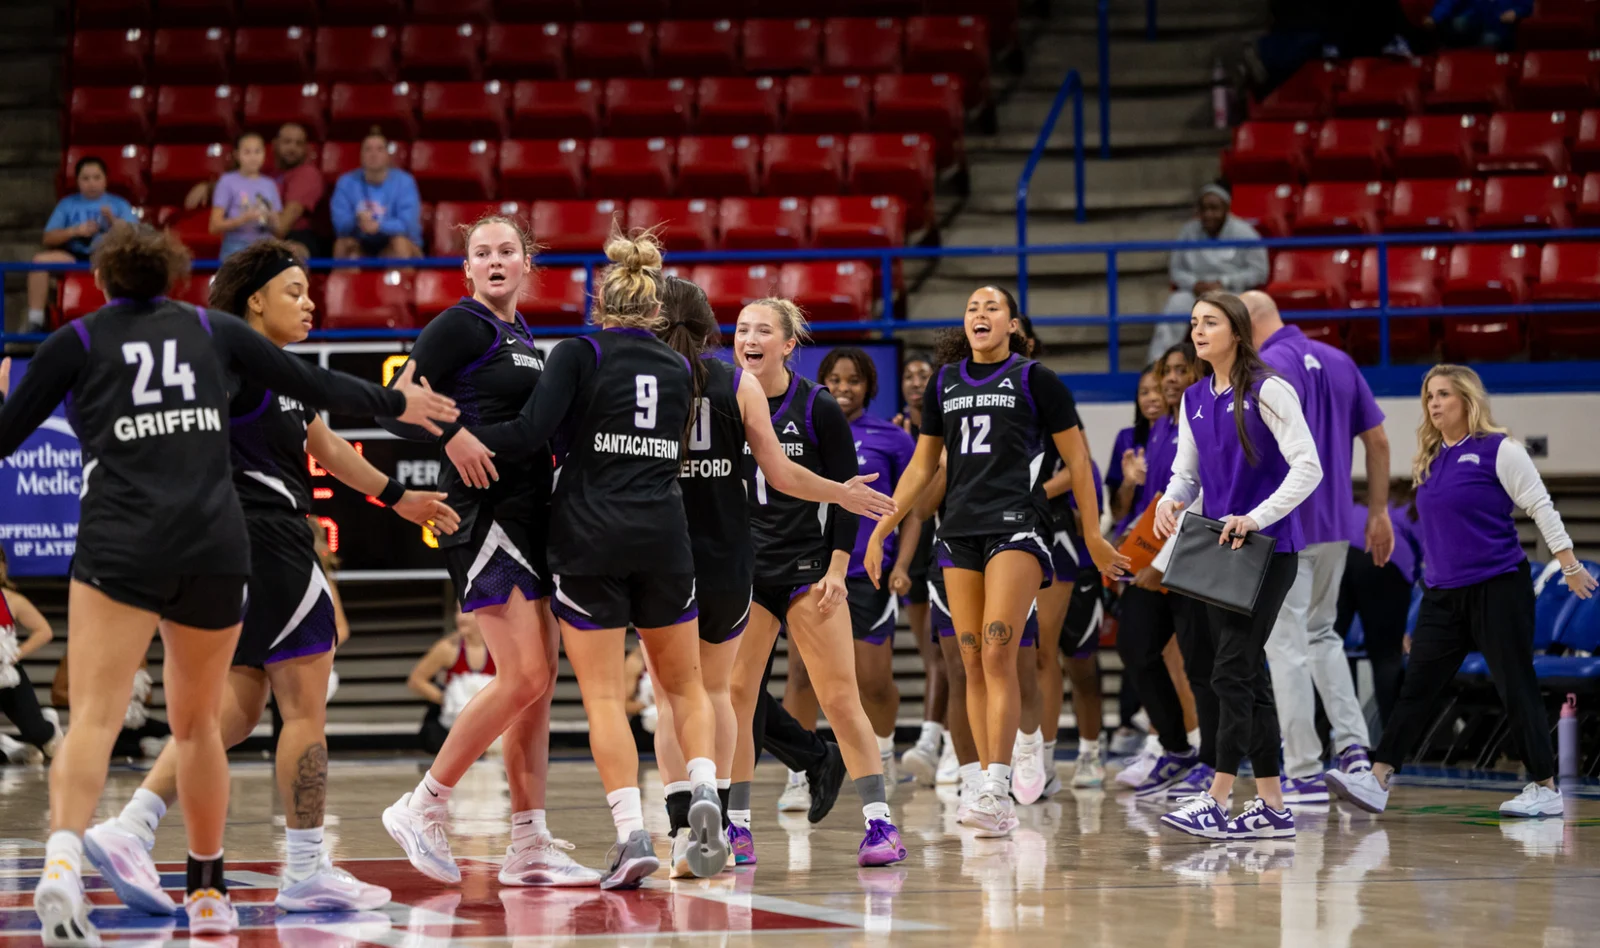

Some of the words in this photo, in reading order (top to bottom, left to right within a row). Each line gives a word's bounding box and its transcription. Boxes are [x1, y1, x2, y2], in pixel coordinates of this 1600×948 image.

[121, 339, 197, 406] 24
[634, 374, 658, 430] 9
[943, 395, 974, 414] SUGAR
[976, 394, 1016, 408] BEARS
[113, 407, 222, 442] GRIFFIN
[960, 414, 992, 455] 12
[593, 432, 679, 460] SANTACATERIN
[16, 469, 81, 495] Medic
[679, 458, 732, 478] EFORD
[35, 541, 76, 557] LATE
